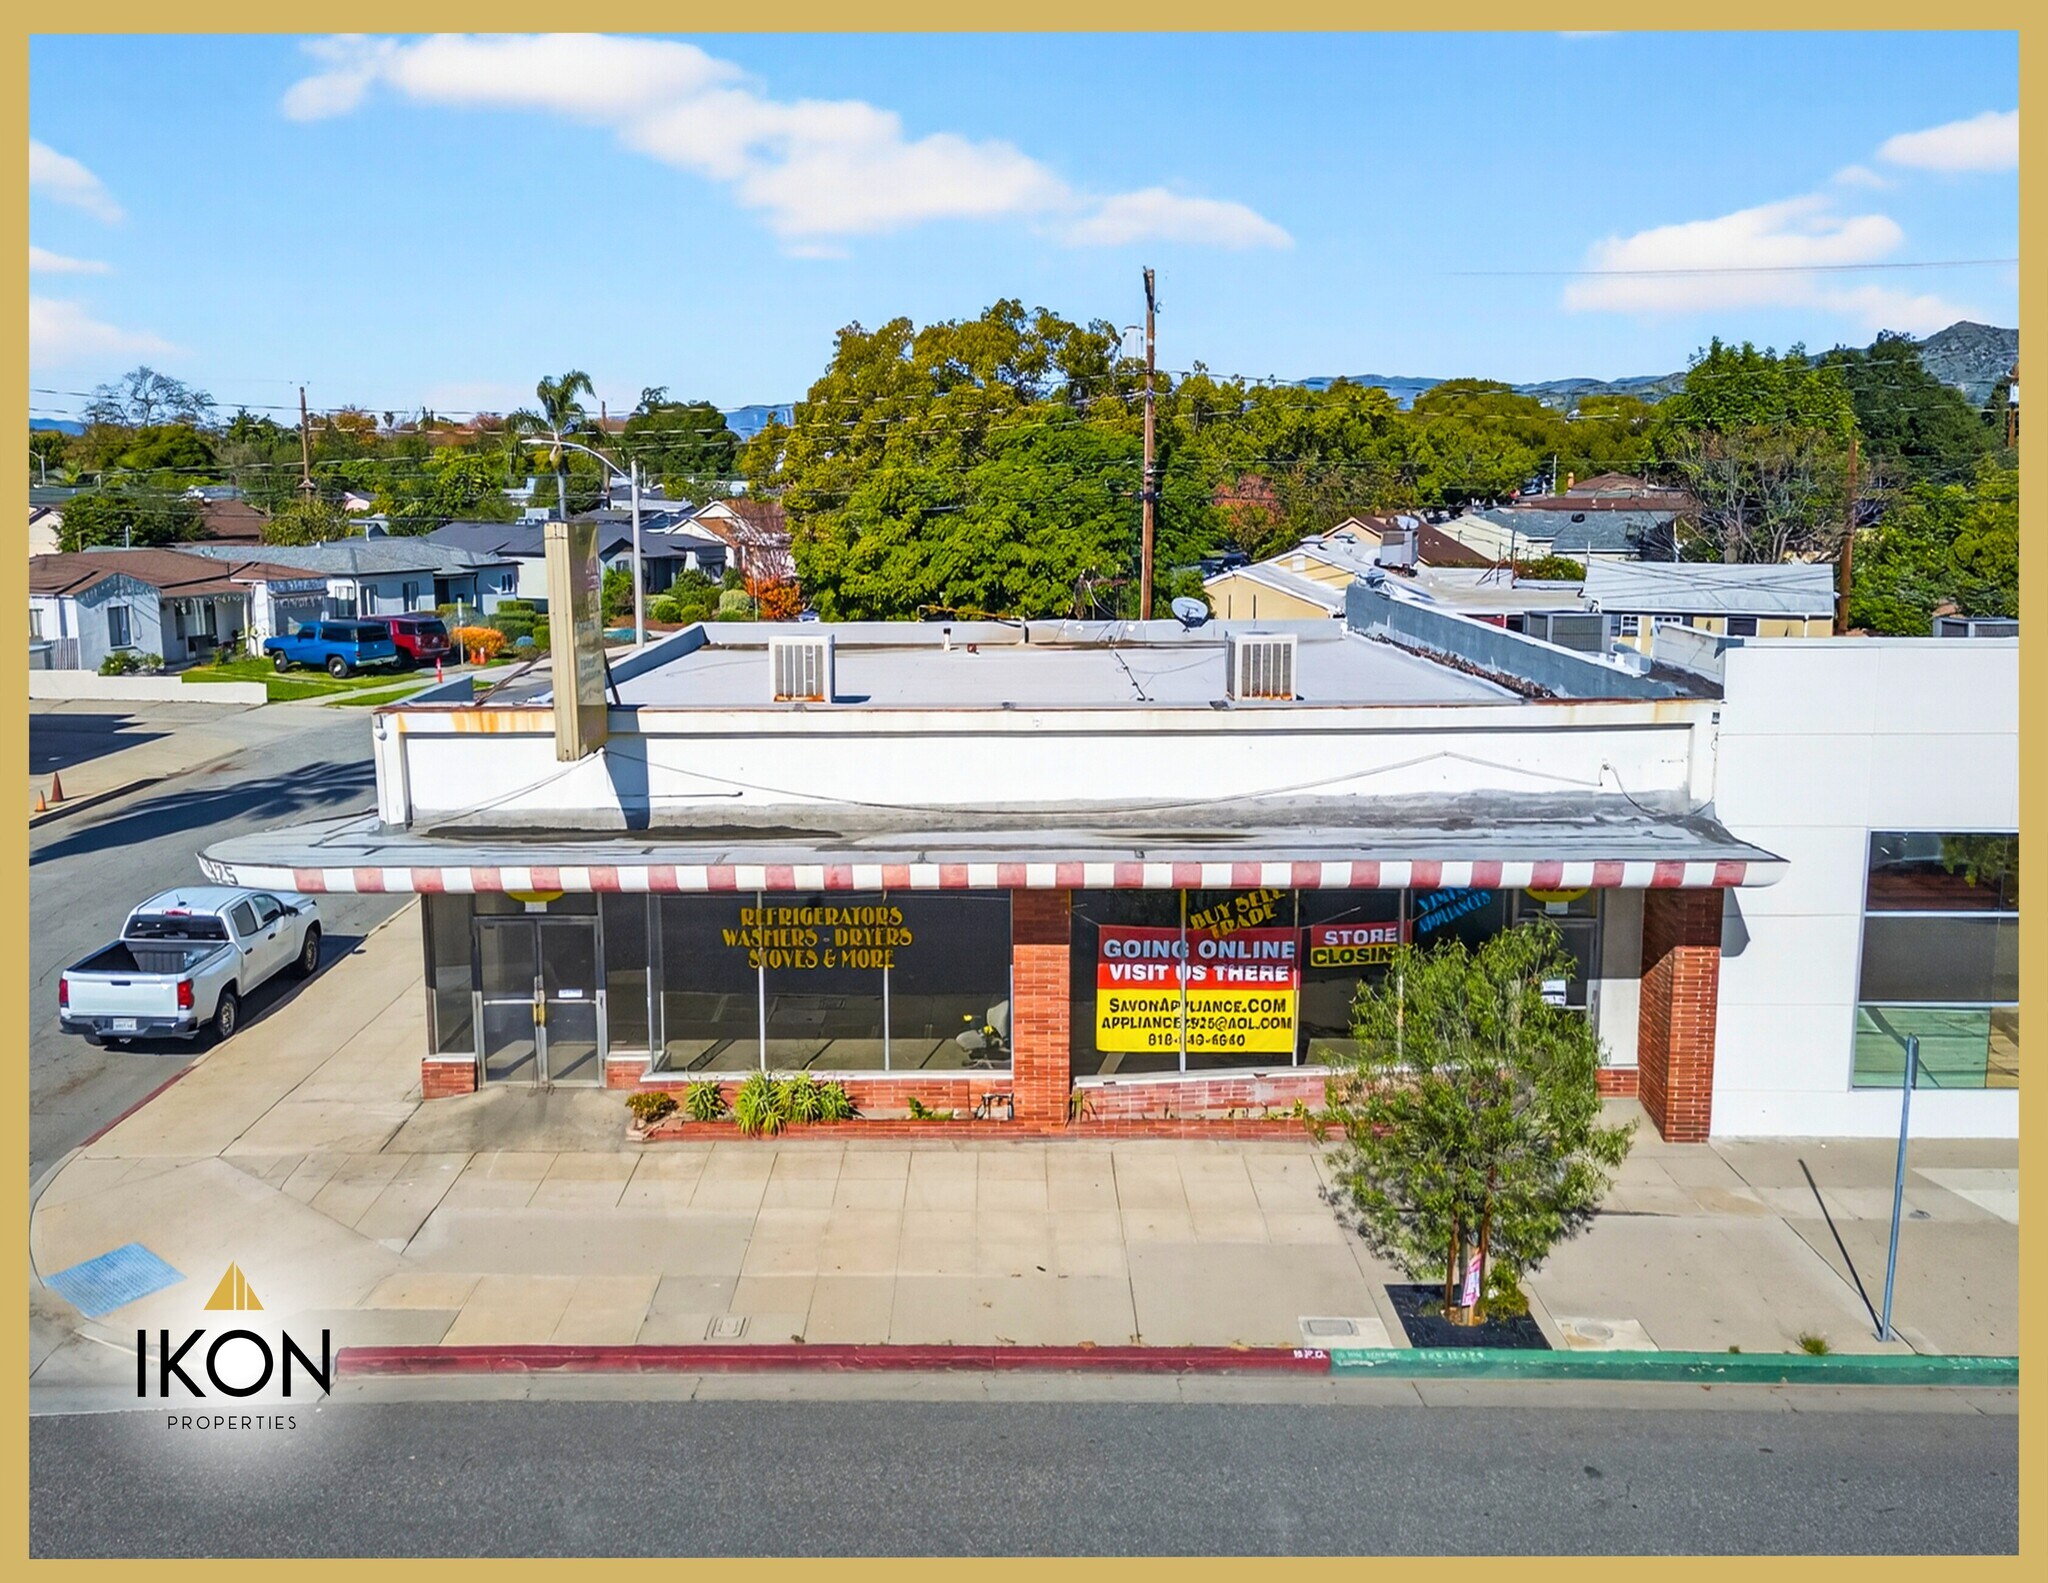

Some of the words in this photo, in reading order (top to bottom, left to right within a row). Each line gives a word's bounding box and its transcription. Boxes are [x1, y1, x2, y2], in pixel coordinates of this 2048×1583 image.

[741, 907, 903, 926] REFRIGERATORS
[1190, 902, 1230, 930] BUY
[1209, 904, 1277, 939] TRADE
[722, 928, 818, 947] WASHERS
[834, 928, 913, 947] DRYERS
[1324, 927, 1397, 945] STORE
[824, 949, 836, 968] &
[842, 949, 895, 968] MORE
[1103, 940, 1189, 958] GOING
[1198, 940, 1295, 958] ONLINE
[1313, 947, 1394, 964] CLOSIN
[1109, 964, 1168, 981] VISIT
[1175, 964, 1207, 981] US
[1213, 965, 1290, 982] THERE
